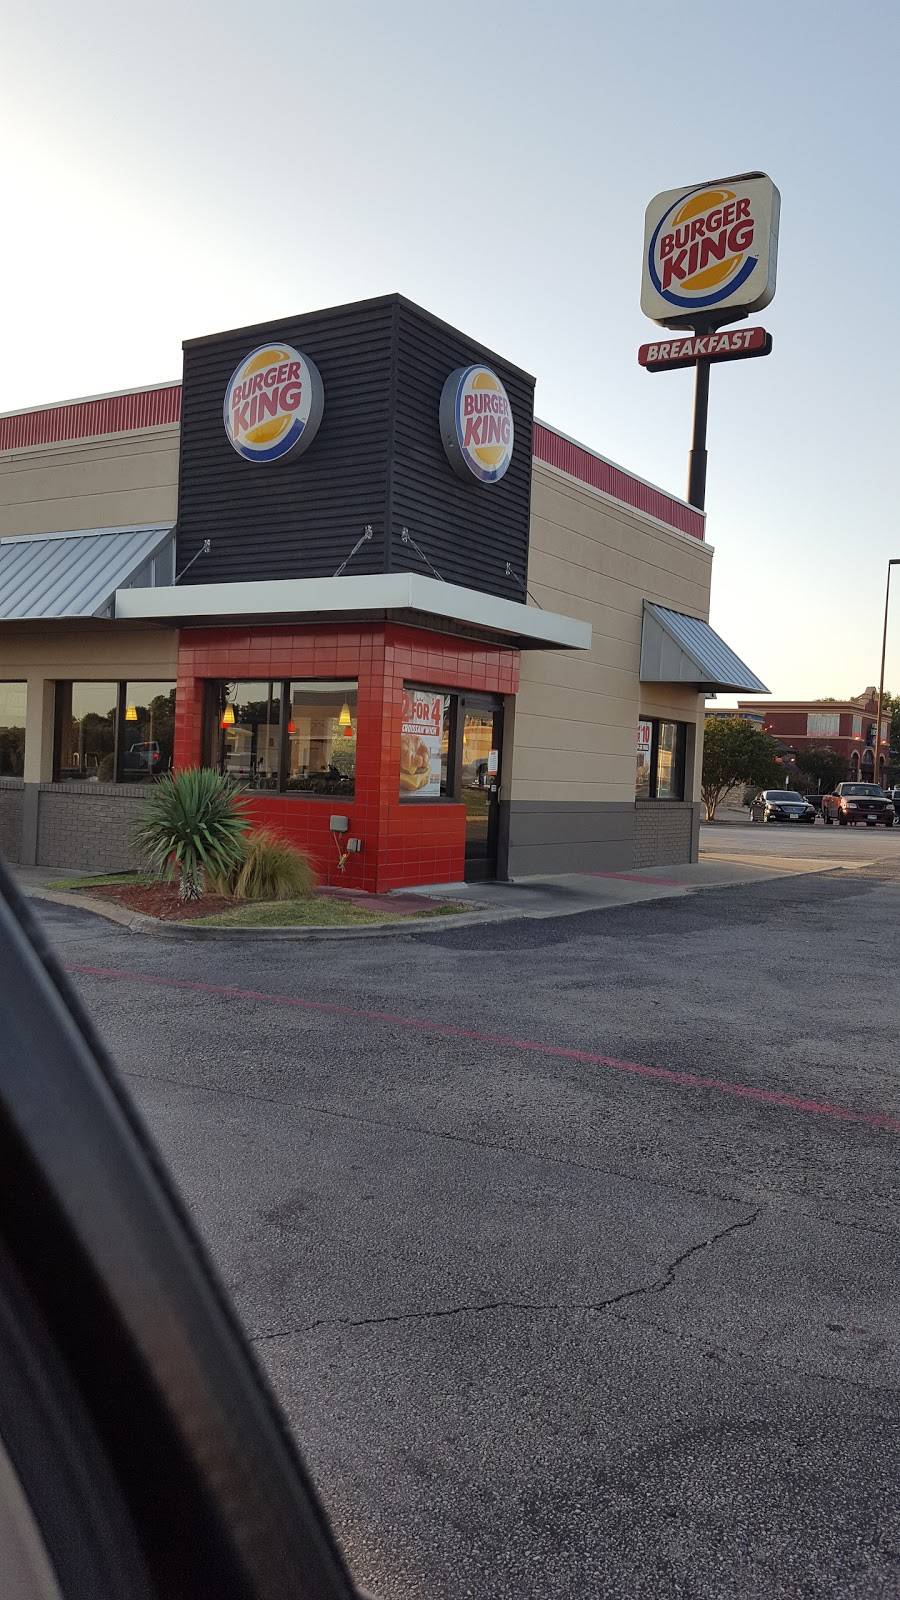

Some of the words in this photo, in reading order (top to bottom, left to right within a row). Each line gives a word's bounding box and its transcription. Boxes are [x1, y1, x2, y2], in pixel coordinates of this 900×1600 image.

[659, 198, 751, 260] BURGER
[661, 219, 755, 290] KING
[646, 330, 755, 363] BREAKFAST
[232, 361, 301, 408] BURGER
[463, 393, 511, 416] BURGER
[232, 381, 303, 440] KING
[462, 415, 511, 449] KING
[412, 702, 429, 721] FOR
